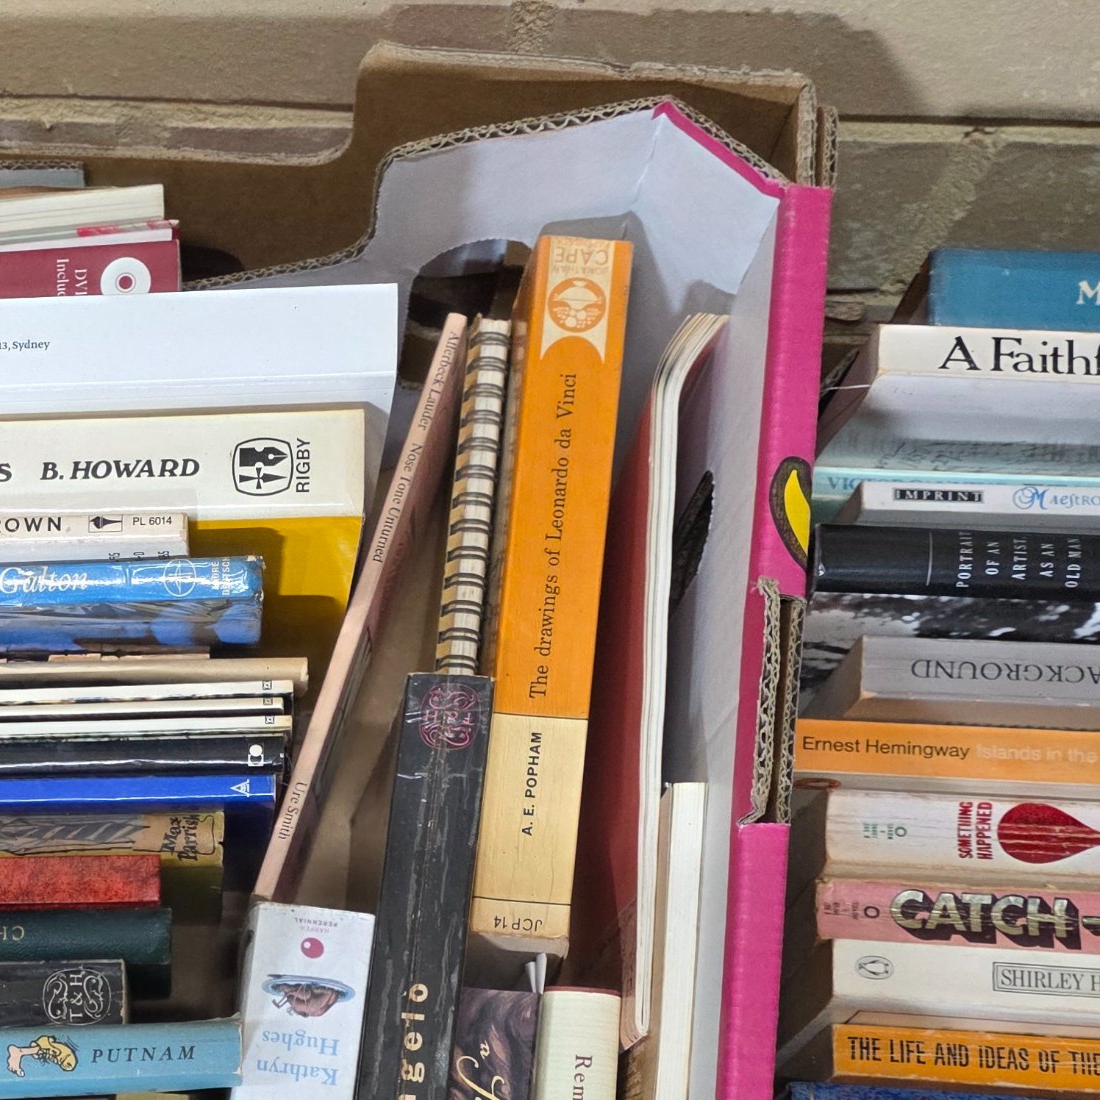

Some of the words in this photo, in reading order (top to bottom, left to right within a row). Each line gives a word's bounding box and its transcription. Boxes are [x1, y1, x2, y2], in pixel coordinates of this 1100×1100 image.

[553, 248, 610, 266] CAPE
[12, 339, 50, 352] Sydney
[556, 372, 577, 420] Vinci
[555, 427, 573, 449] da
[293, 438, 312, 493] RIGBY
[544, 455, 569, 542] Leonardo
[893, 489, 983, 502] IMPRINT
[132, 516, 146, 527] PL
[148, 515, 172, 527] 6014
[547, 547, 560, 566] of
[533, 574, 561, 658] drawings
[529, 664, 549, 699] The
[802, 736, 861, 753] Ernest
[865, 738, 970, 760] Hemingway
[977, 744, 1041, 761] Islands
[1046, 745, 1062, 761] in
[1067, 745, 1098, 764] the
[525, 731, 543, 799] POPHAM
[524, 804, 536, 817] E.
[521, 822, 534, 836] A.
[958, 801, 974, 859] SOMETHING
[976, 801, 994, 860] HAPPENED
[511, 917, 543, 932] JCP
[1001, 967, 1085, 991] SHIRLEY
[91, 1045, 196, 1063] PUTNAM
[262, 1029, 339, 1055] Hughes
[848, 1036, 881, 1062] THE
[889, 1039, 926, 1065] LIFE
[934, 1042, 970, 1067] AND
[978, 1045, 1030, 1070] IDEAS
[1038, 1049, 1060, 1074] OF
[256, 1056, 338, 1086] Kathryn
